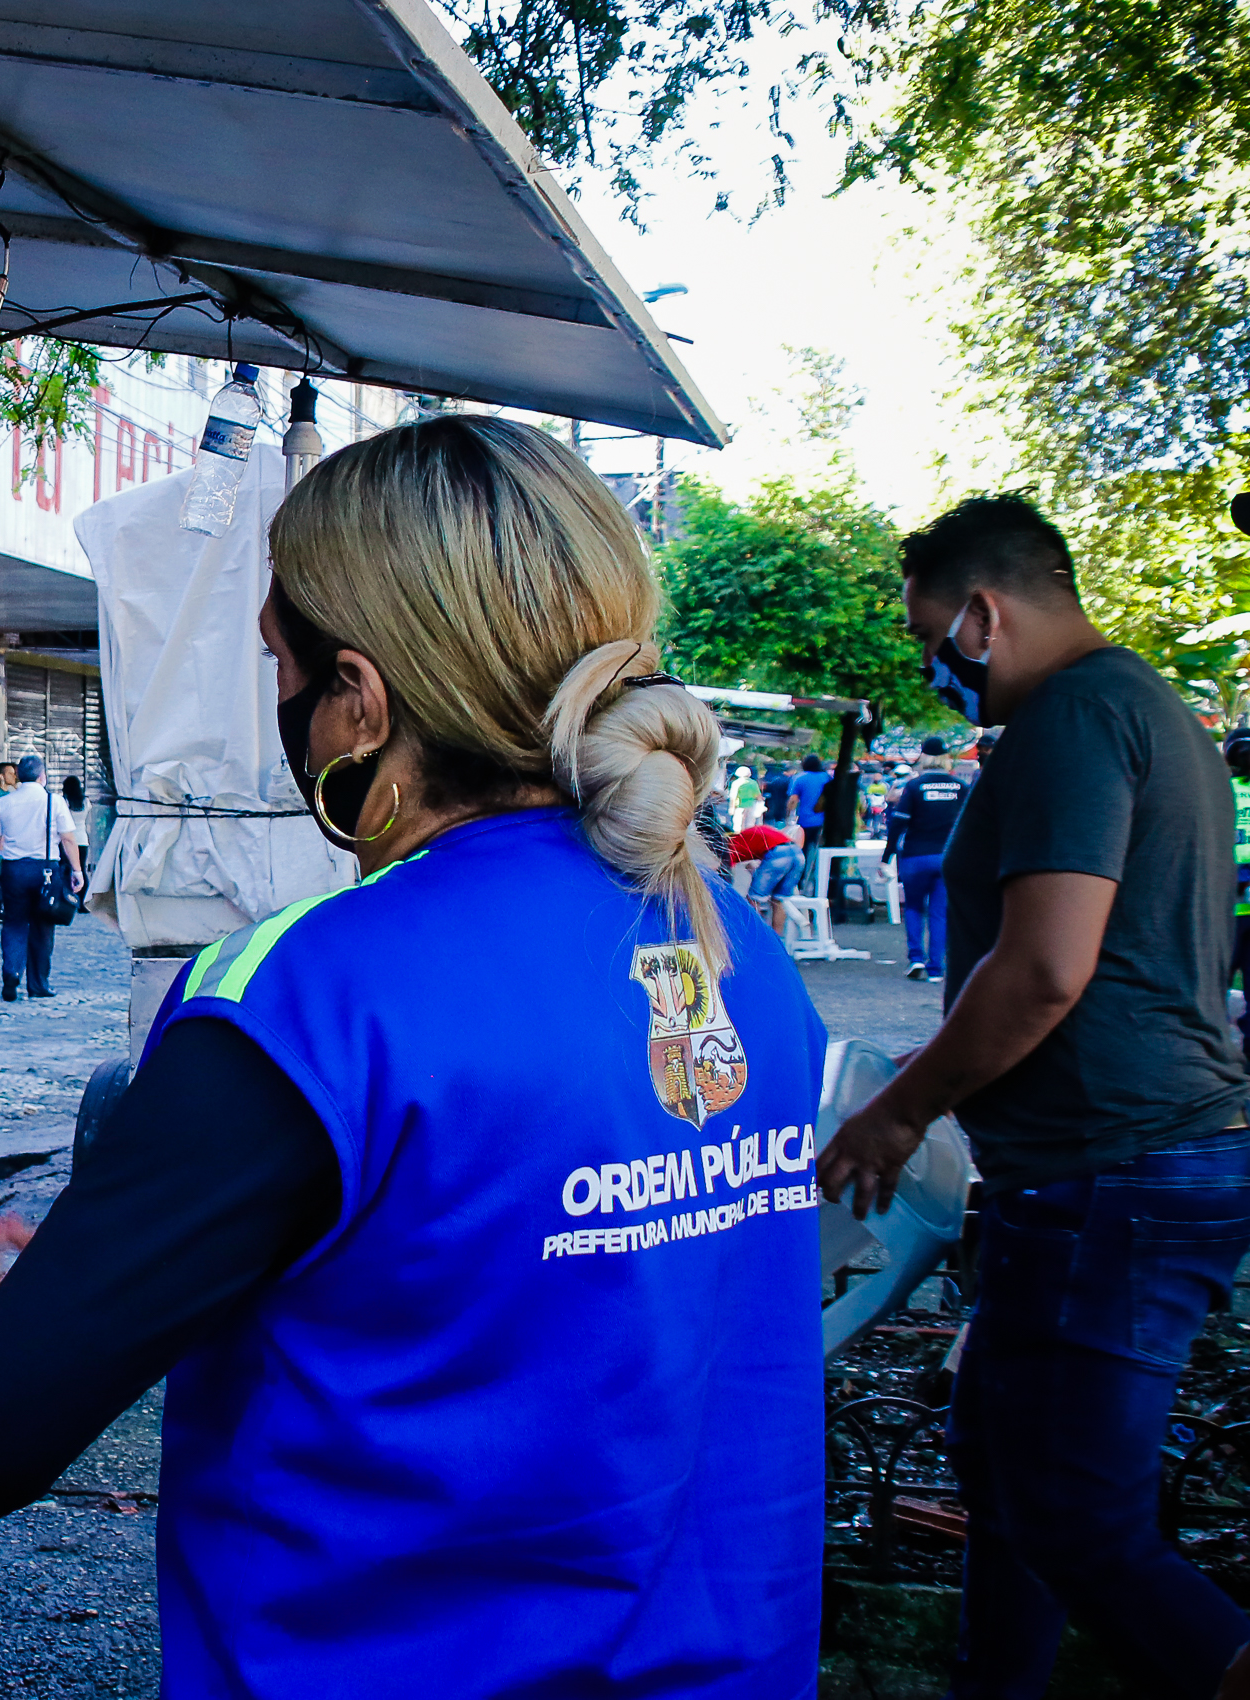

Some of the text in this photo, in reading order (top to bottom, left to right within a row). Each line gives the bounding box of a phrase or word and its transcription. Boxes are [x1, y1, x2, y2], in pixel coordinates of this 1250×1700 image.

[562, 1124, 816, 1217] ORDEM PÚBLICA
[542, 1218, 668, 1260] PREFEITURA
[670, 1198, 746, 1242] MUNICIPAL
[746, 1189, 769, 1218] DE
